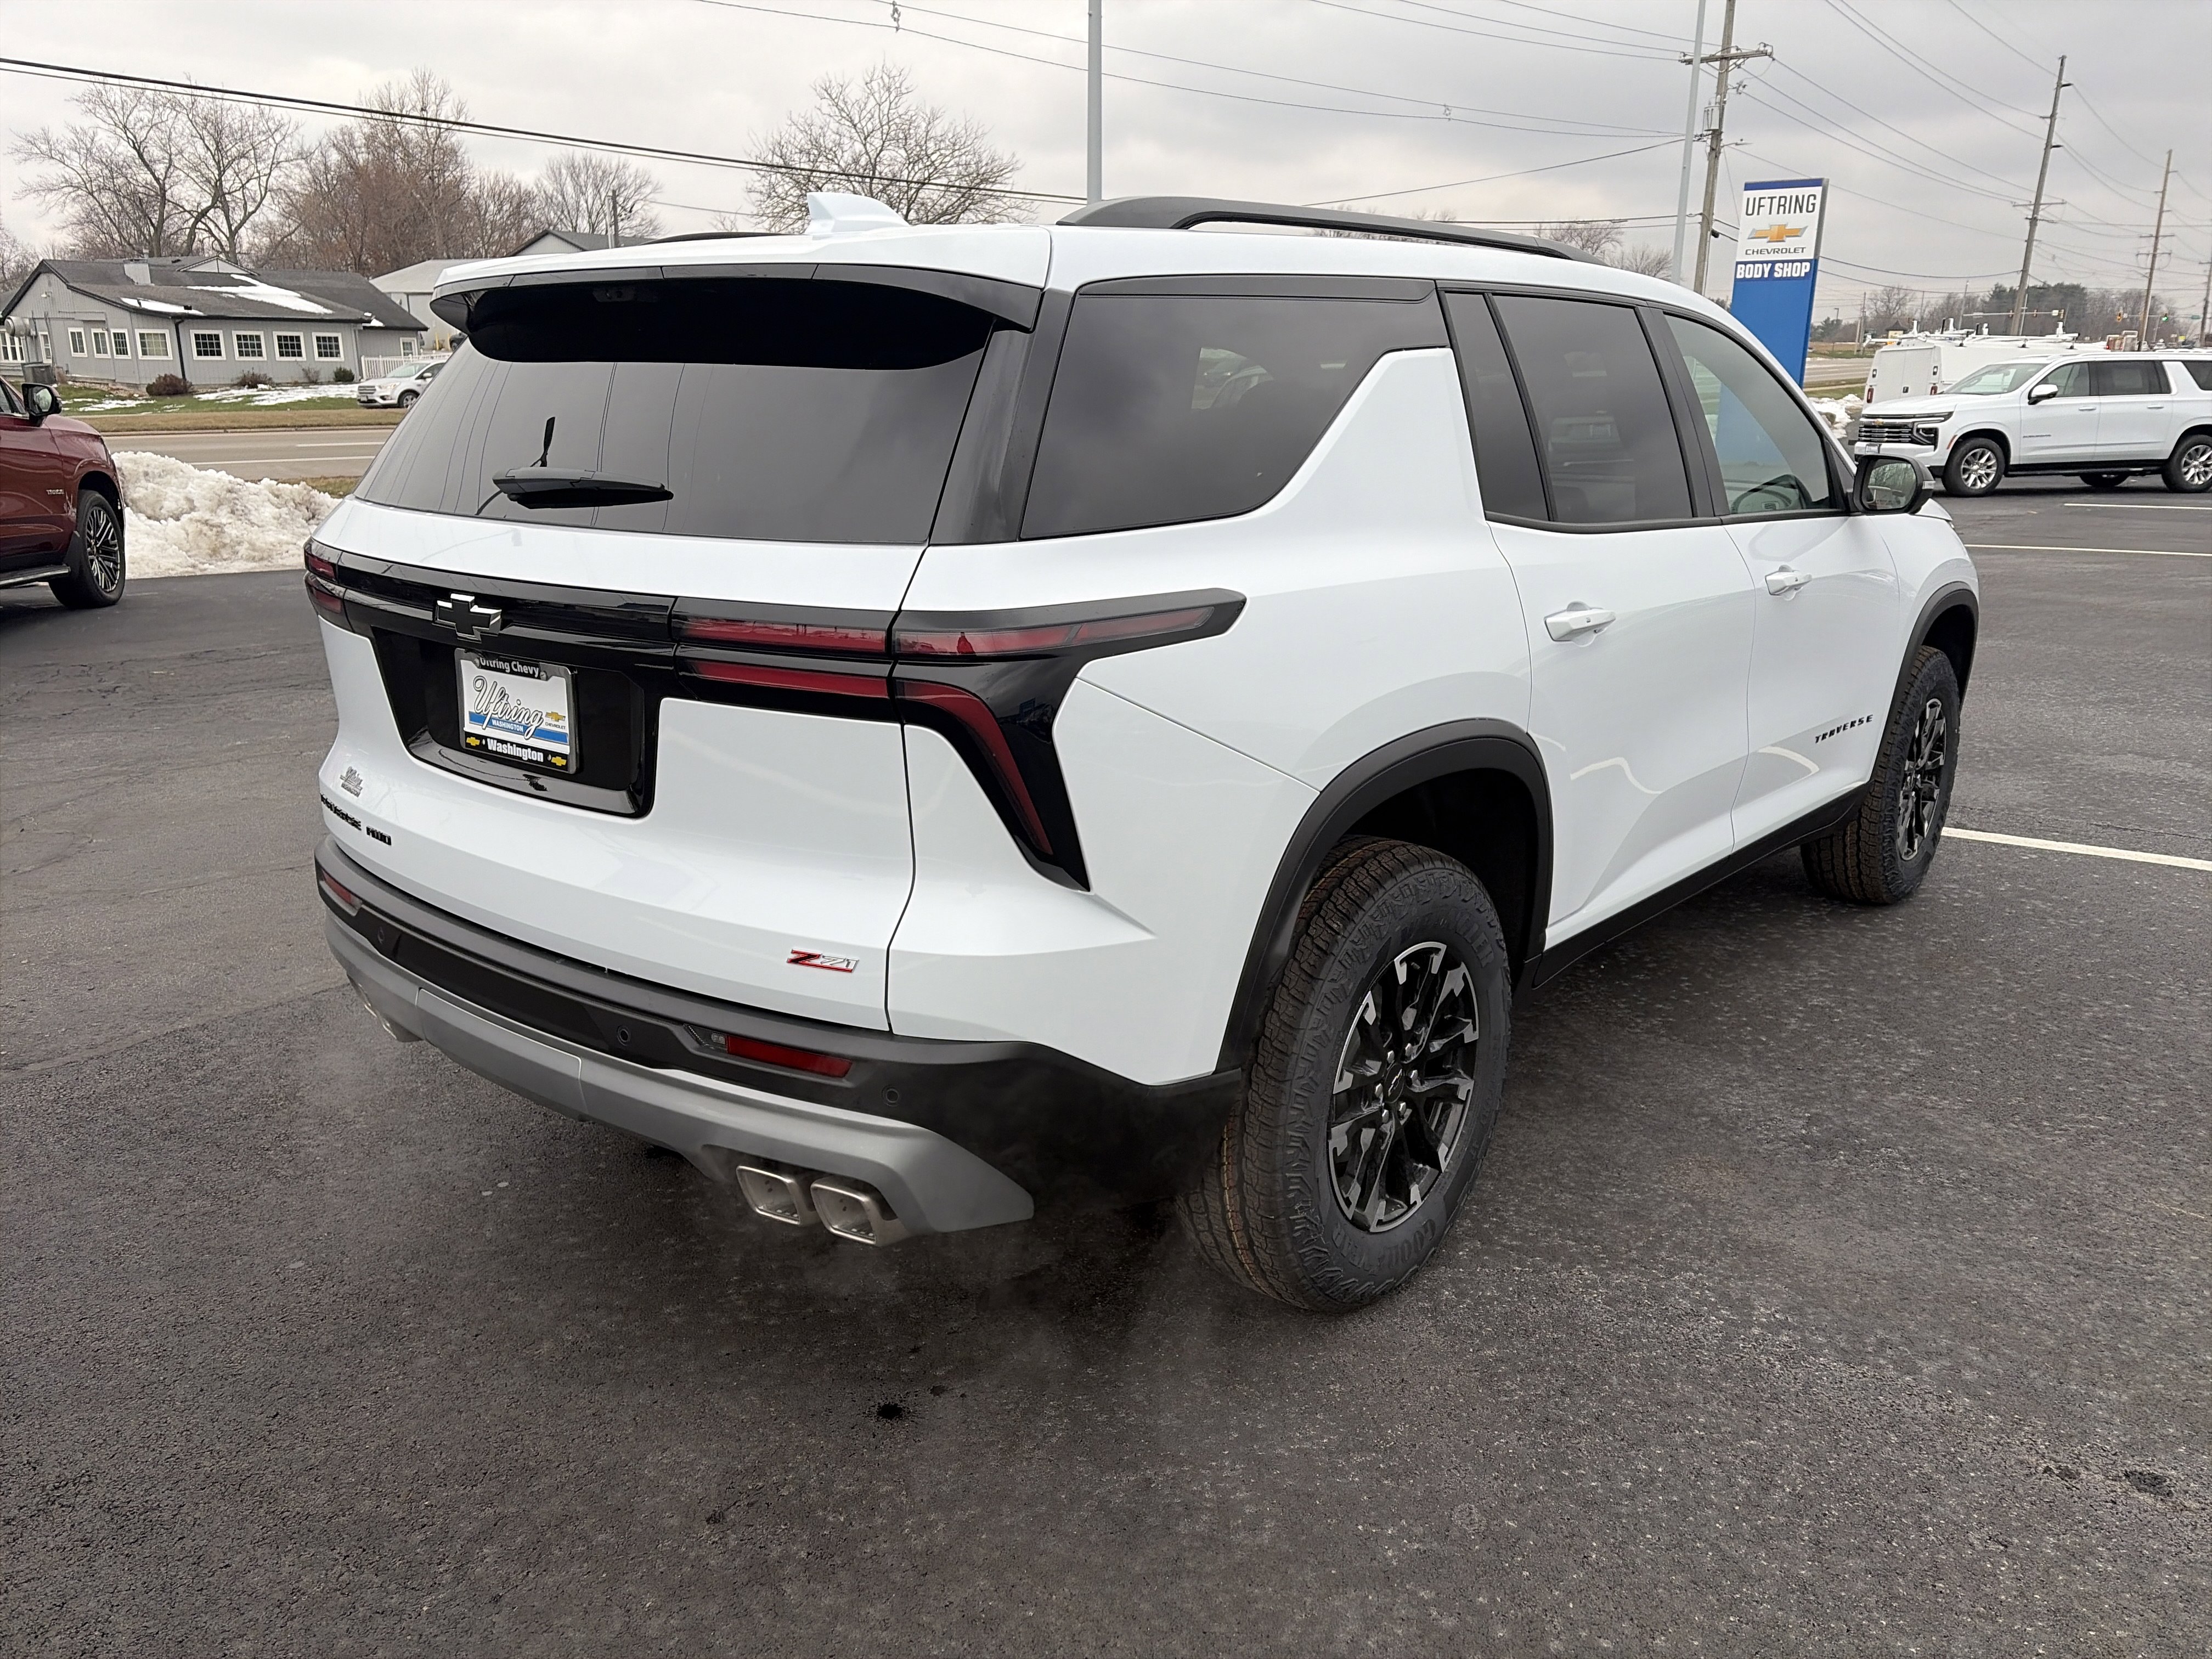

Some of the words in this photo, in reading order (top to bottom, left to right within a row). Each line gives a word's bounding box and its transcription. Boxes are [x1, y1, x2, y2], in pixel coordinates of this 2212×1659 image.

[1745, 194, 1817, 216] UFTRING
[1745, 247, 1806, 255] CHEVROLET
[1736, 263, 1772, 279] BODY
[1774, 262, 1810, 278] SHOP
[511, 661, 539, 678] Chevy
[473, 675, 544, 740] Uftring
[492, 719, 524, 732] WASHINGTON
[1815, 714, 1873, 743] TRAVERSE
[487, 738, 544, 762] Washington
[786, 949, 860, 973] Z71
